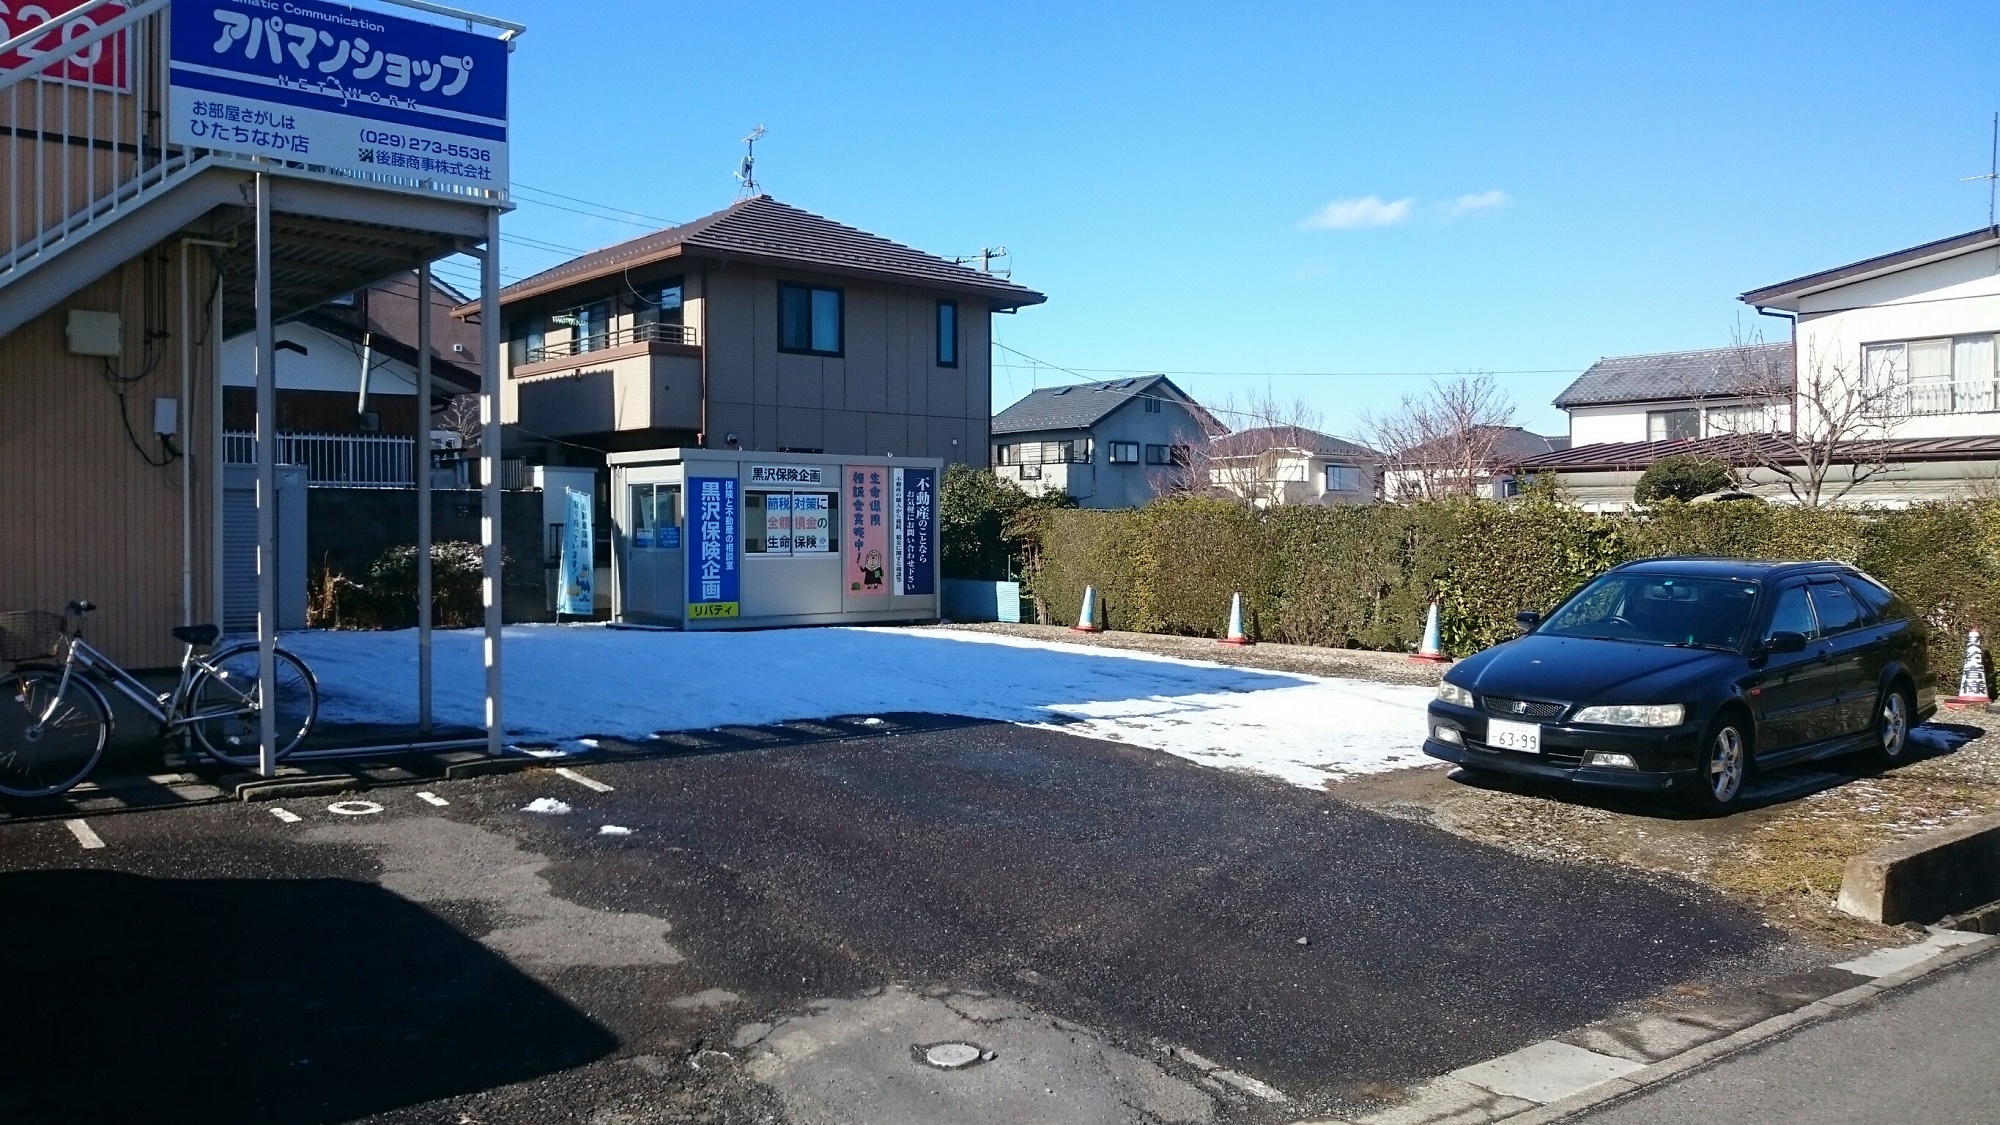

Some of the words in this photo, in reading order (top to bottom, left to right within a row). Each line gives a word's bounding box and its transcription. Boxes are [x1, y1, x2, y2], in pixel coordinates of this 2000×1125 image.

[283, 2, 385, 33] Communication
[213, 8, 473, 96] アパマンショップ
[192, 100, 296, 130] お部屋さがしは
[190, 119, 310, 154] ひたちなか店
[375, 149, 492, 181] 後藤商事株式会社
[752, 467, 821, 483] 黒沢保険企画
[767, 497, 827, 511] 節税対策に
[869, 472, 881, 526] 生命保険
[725, 480, 734, 570] 保険と不動産の相談室
[915, 477, 930, 563] 不動産のことなら
[701, 481, 720, 600] 黒沢保険企画
[767, 535, 817, 549] 生命保険
[906, 490, 915, 590] お気軽にお問い合わせ下さい
[694, 604, 732, 617] リバティ
[1499, 731, 1537, 750] 63-99
